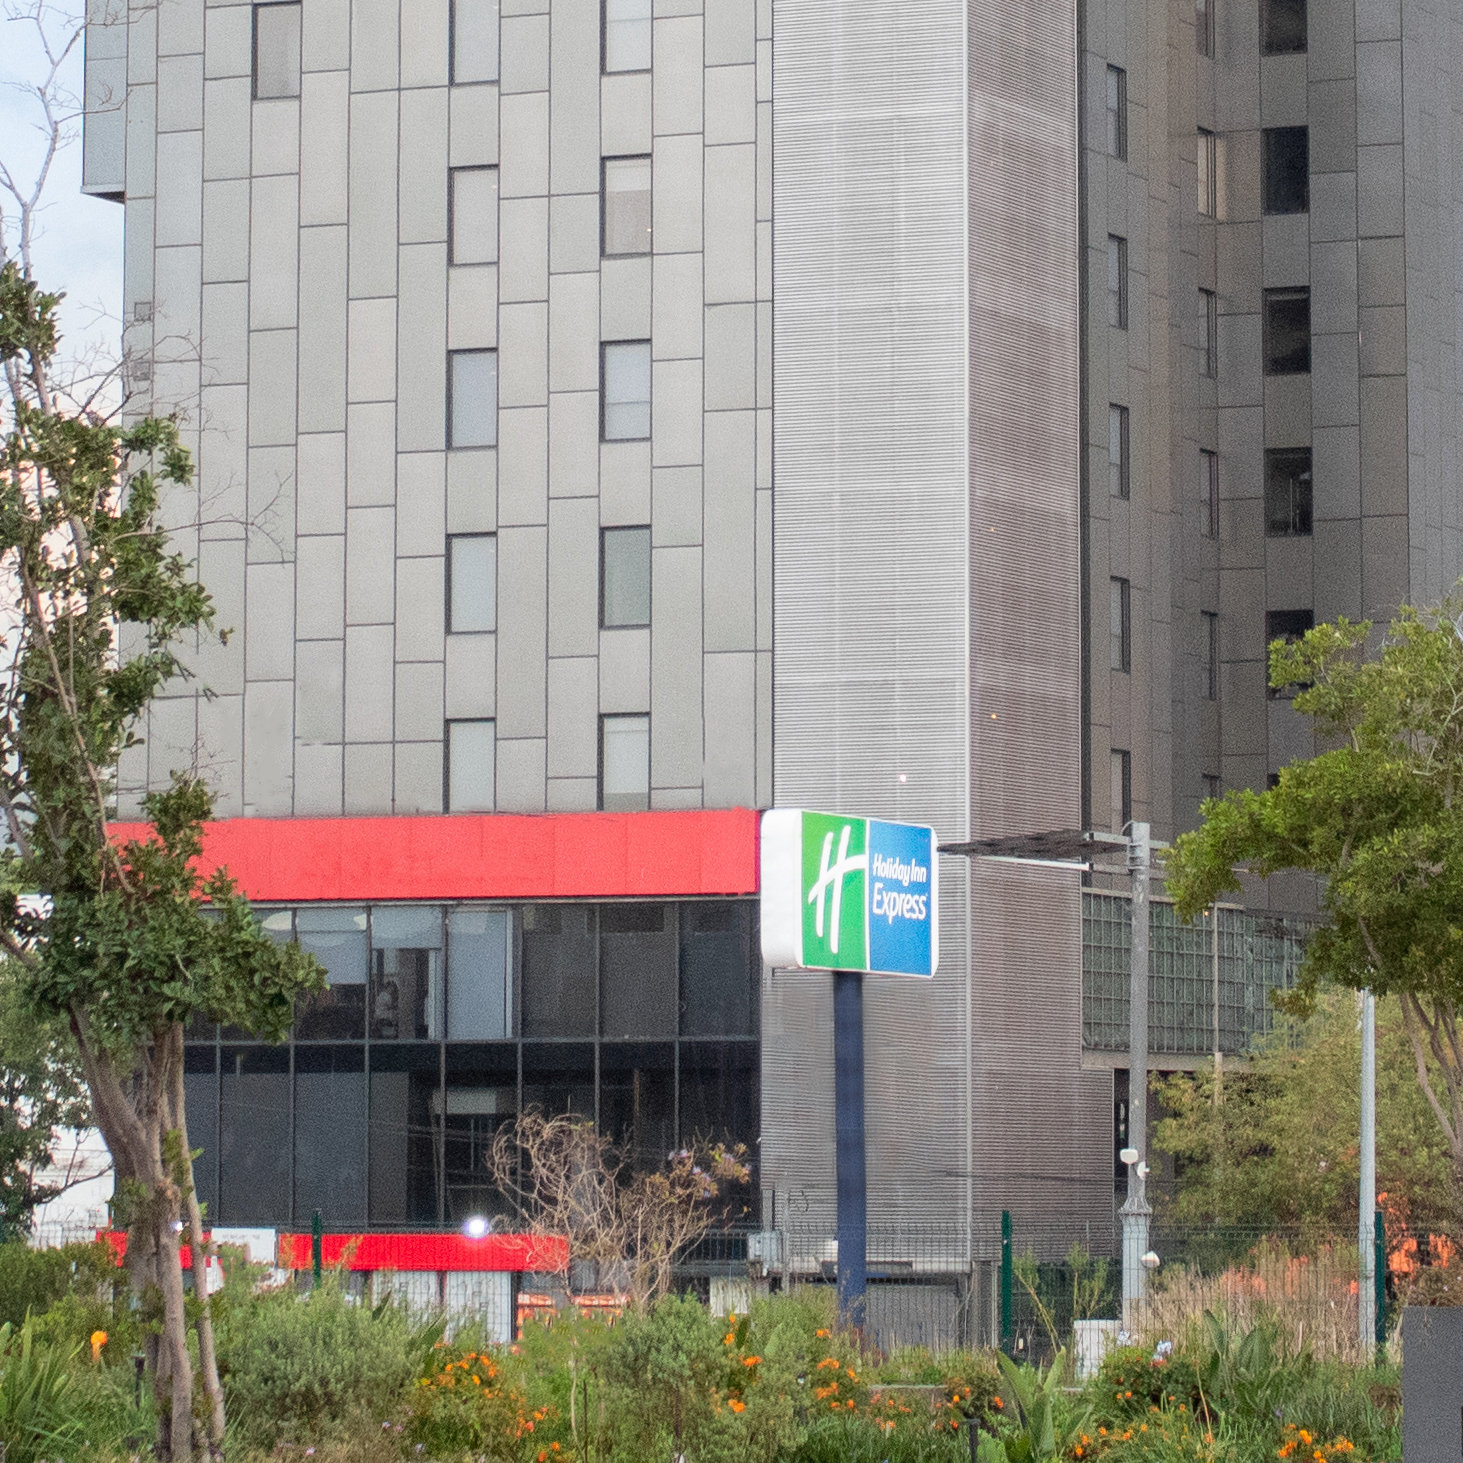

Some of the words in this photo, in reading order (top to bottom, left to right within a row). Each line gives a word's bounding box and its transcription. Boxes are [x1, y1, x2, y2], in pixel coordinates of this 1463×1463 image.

[872, 852, 911, 887] Holiday
[910, 857, 927, 883] Inn
[871, 881, 927, 925] Express
